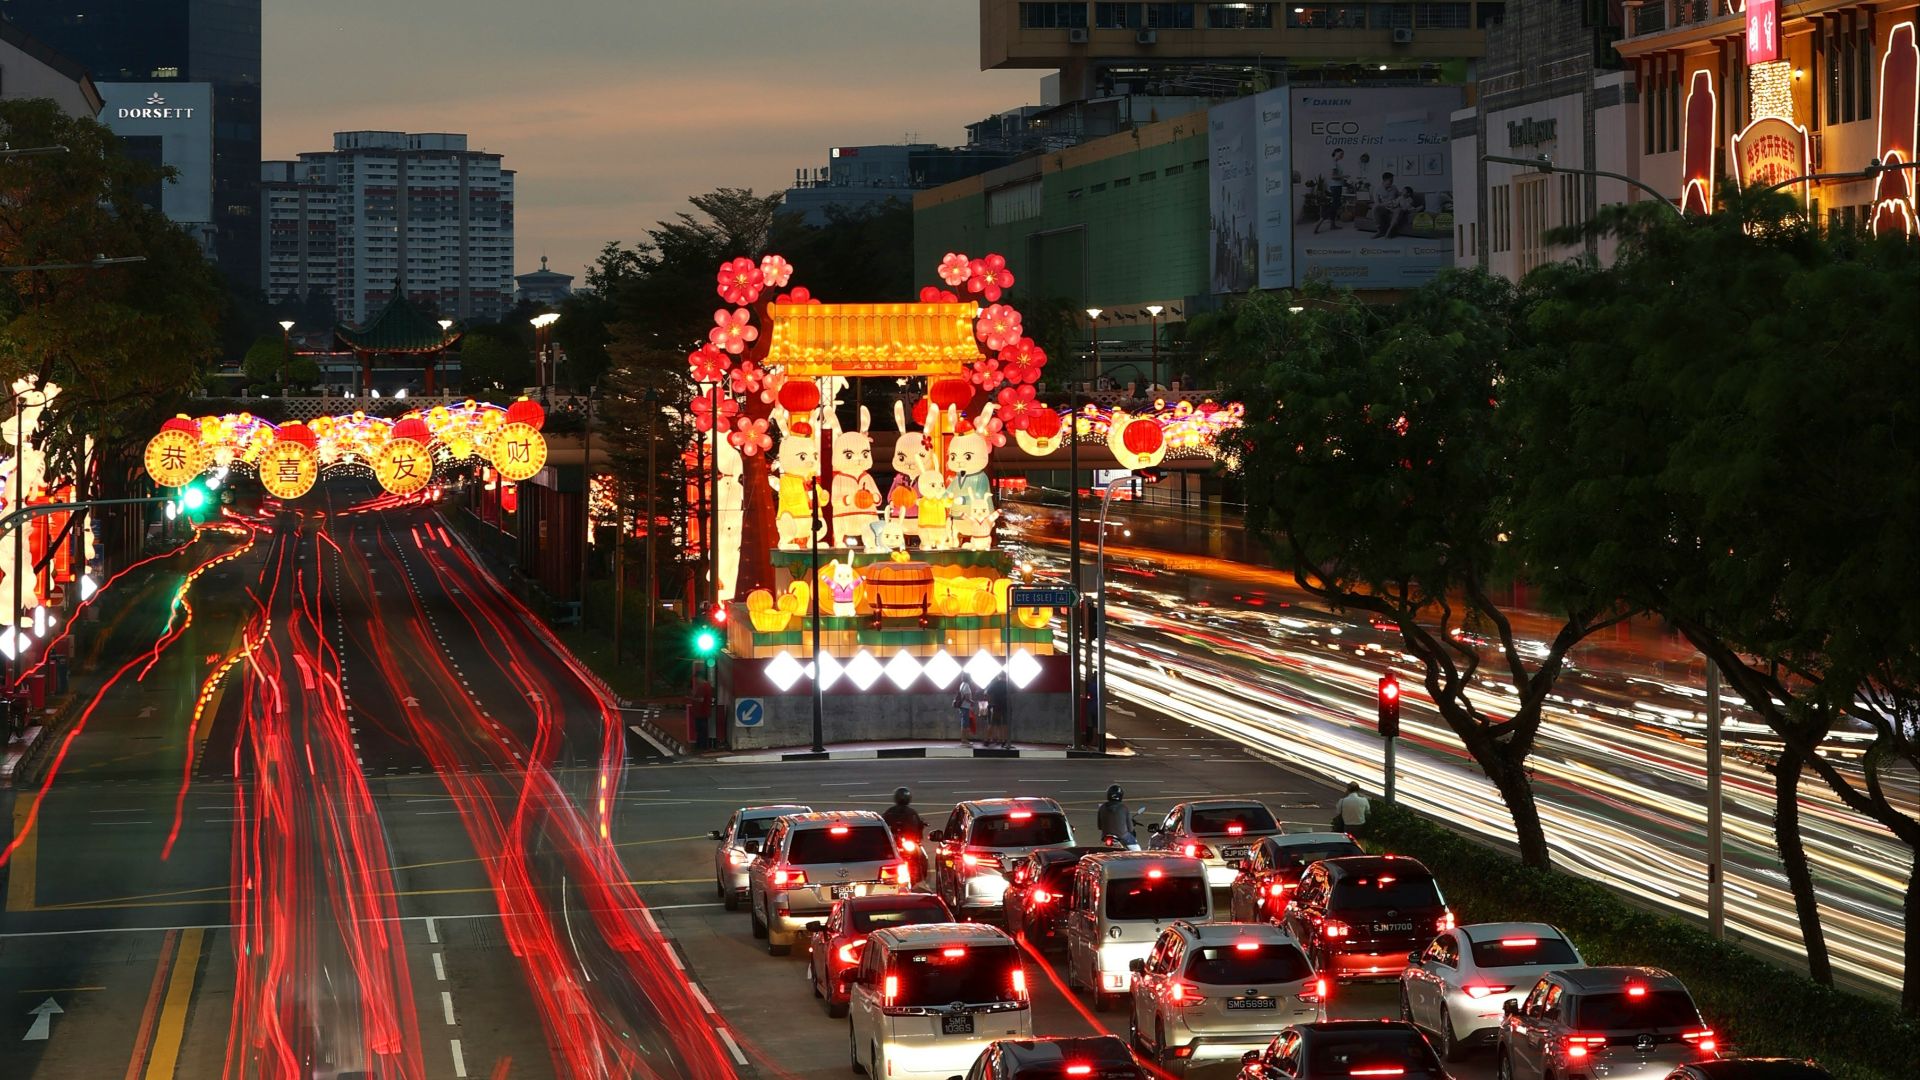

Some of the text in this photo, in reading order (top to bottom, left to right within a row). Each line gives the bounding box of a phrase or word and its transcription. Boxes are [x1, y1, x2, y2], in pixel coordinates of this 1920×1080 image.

[1312, 98, 1352, 106] DAIKIN
[118, 108, 194, 119] DORSETT
[1311, 121, 1359, 135] ECO
[1325, 135, 1359, 145] Comes
[1361, 135, 1383, 145] First
[160, 439, 532, 483] 恭 喜 发 财
[1016, 593, 1052, 602] CTE (SLE)
[1373, 923, 1413, 932] SJN7170D
[1228, 1000, 1275, 1009] SMG5699K
[949, 1017, 966, 1025] SMR
[945, 1024, 971, 1033] 1036S
